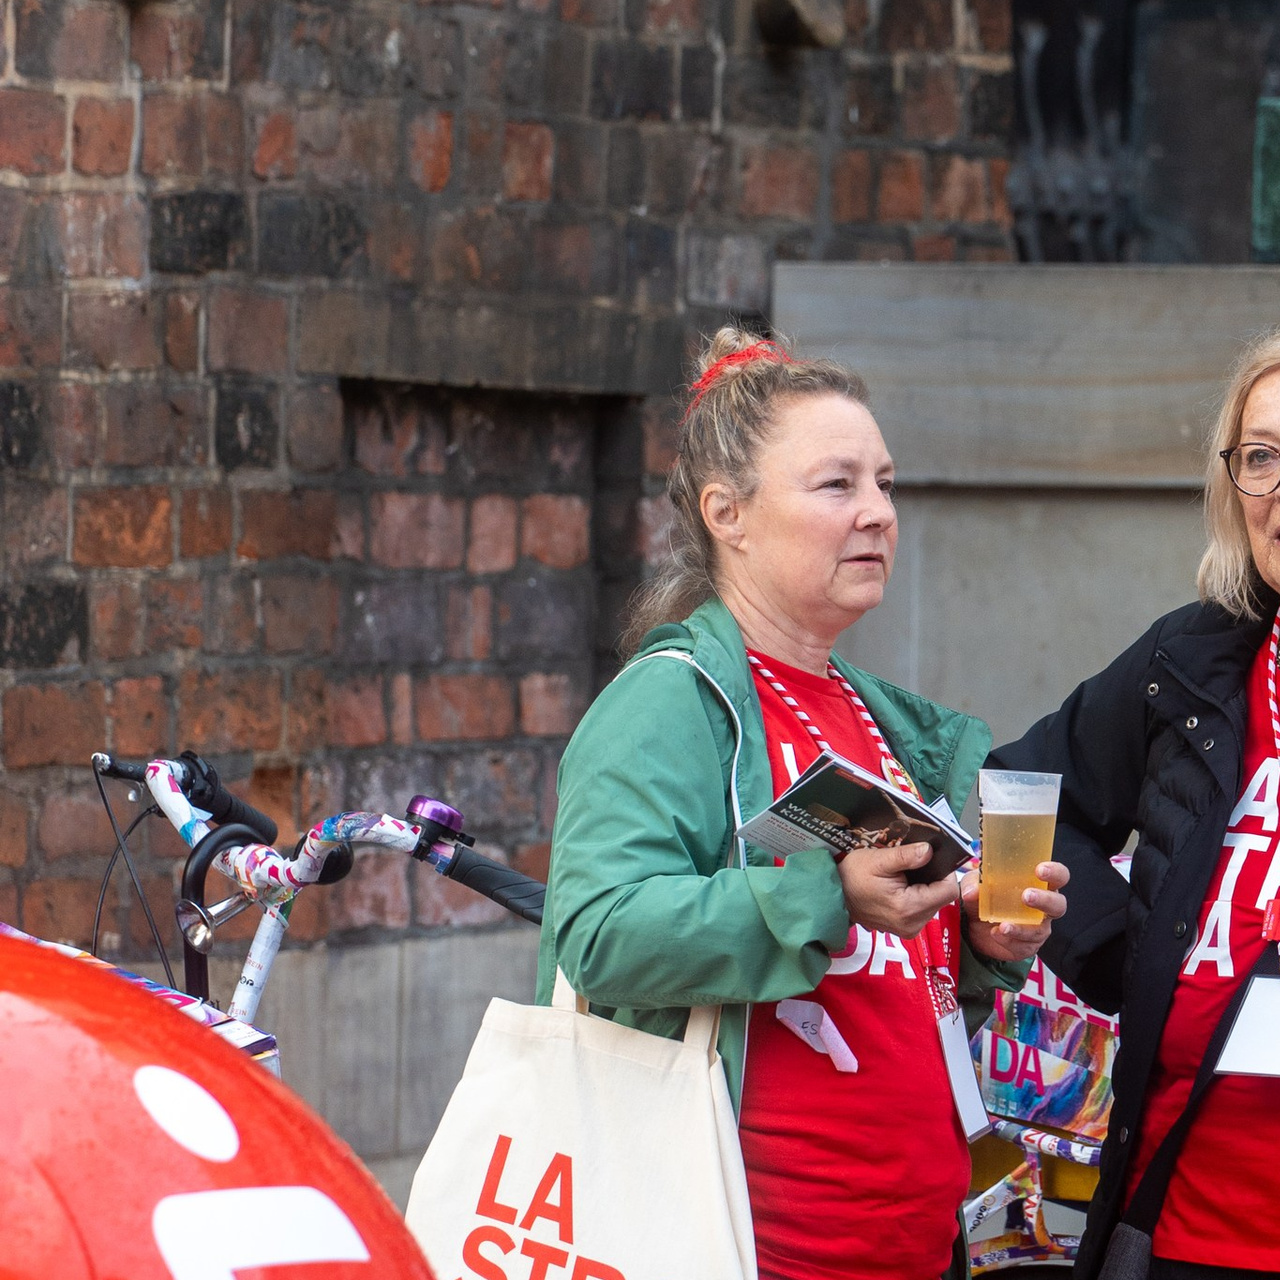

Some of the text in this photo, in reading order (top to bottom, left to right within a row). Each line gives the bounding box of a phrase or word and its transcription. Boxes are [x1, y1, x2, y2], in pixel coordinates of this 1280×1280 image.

[790, 803, 811, 818] Wir
[813, 816, 860, 846] stärken
[989, 1031, 1045, 1096] DA
[475, 1134, 574, 1245] LA
